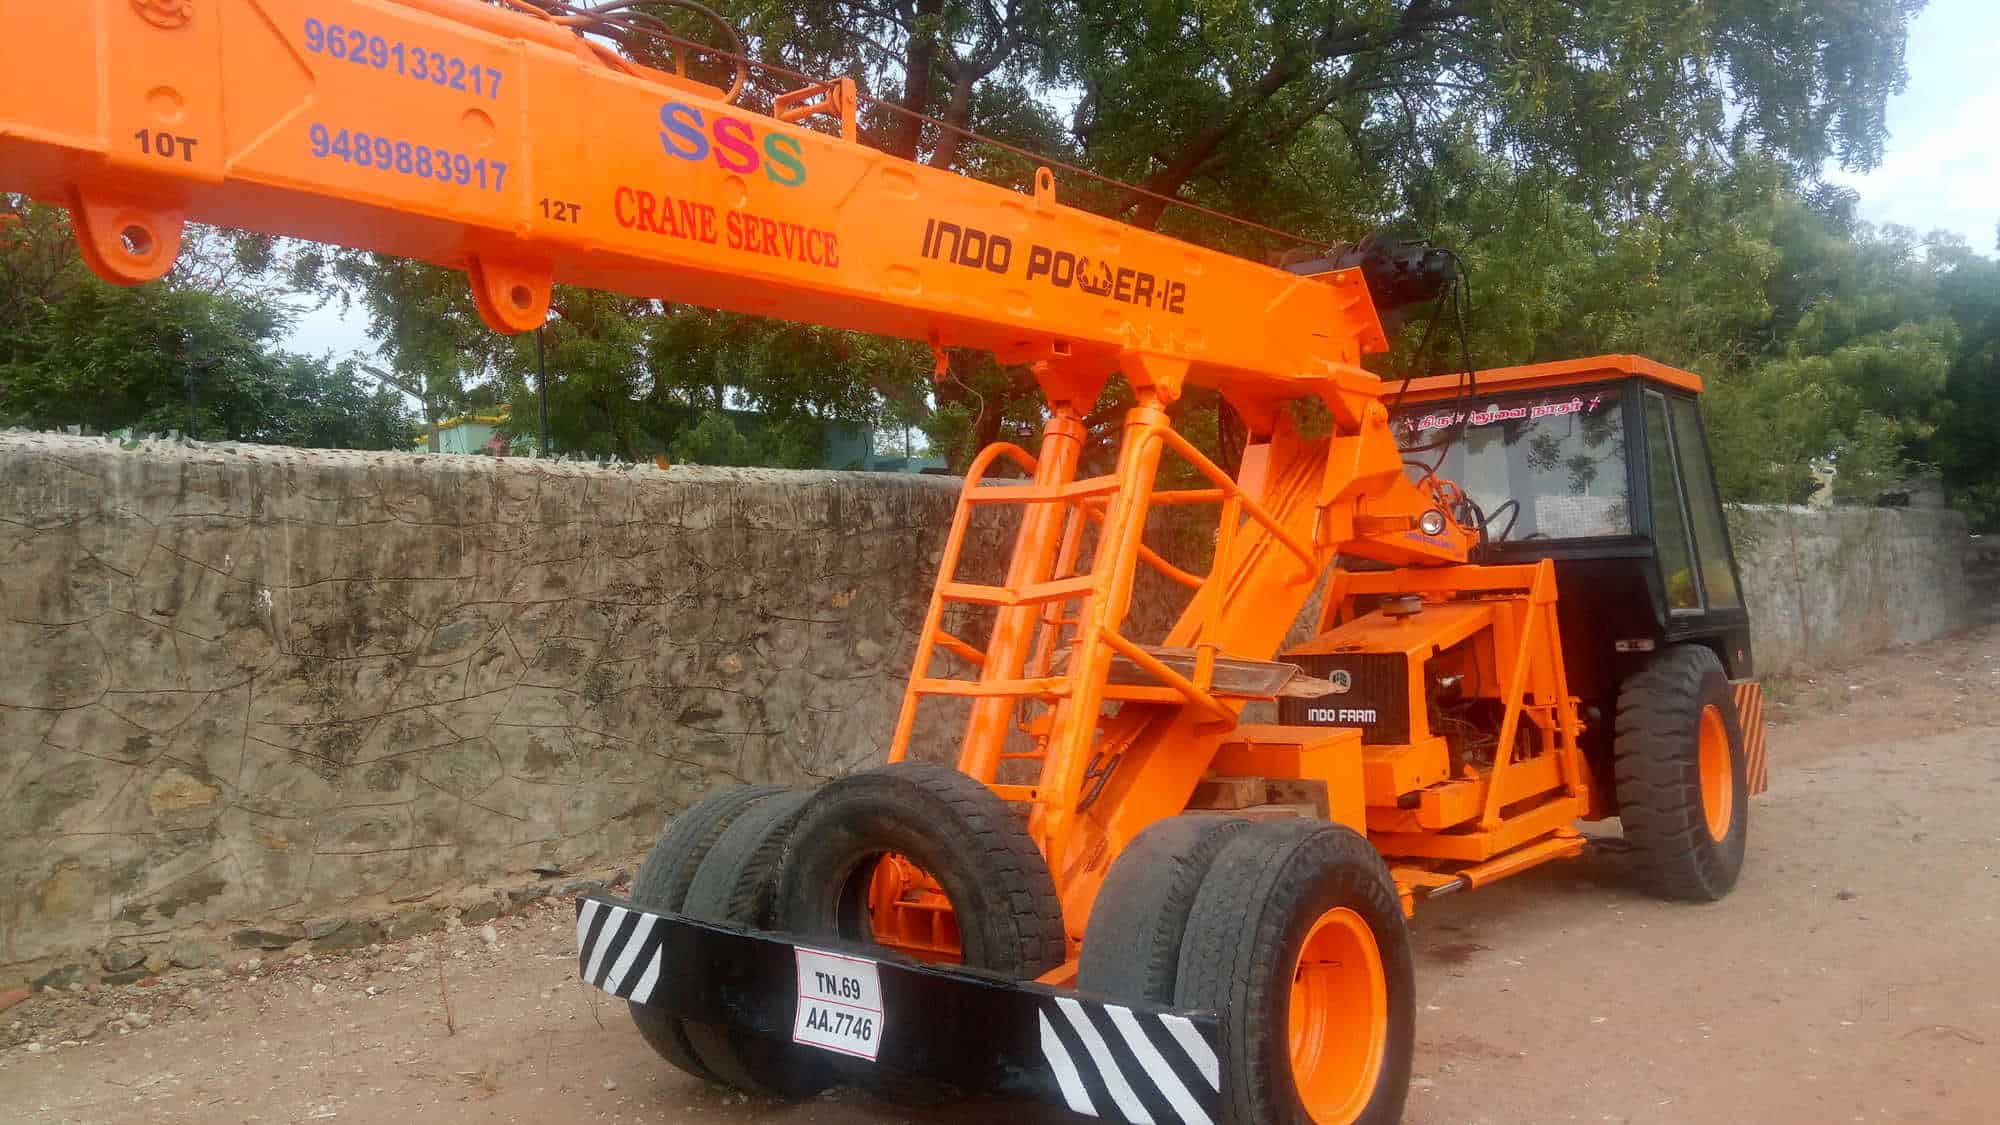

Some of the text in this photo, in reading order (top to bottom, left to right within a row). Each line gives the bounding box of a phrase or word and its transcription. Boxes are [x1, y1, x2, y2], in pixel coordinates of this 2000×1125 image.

[304, 17, 503, 99] 9629133217
[135, 128, 198, 162] 10T
[309, 122, 508, 192] 9489883917
[660, 102, 806, 187] SSS
[539, 198, 581, 224] 12T
[614, 185, 840, 269] CRANE SERVICE
[921, 218, 1012, 274] INDO
[1308, 708, 1377, 723] INDO FARM
[815, 971, 861, 1000] TN.69
[806, 1007, 873, 1041] AA.7746
